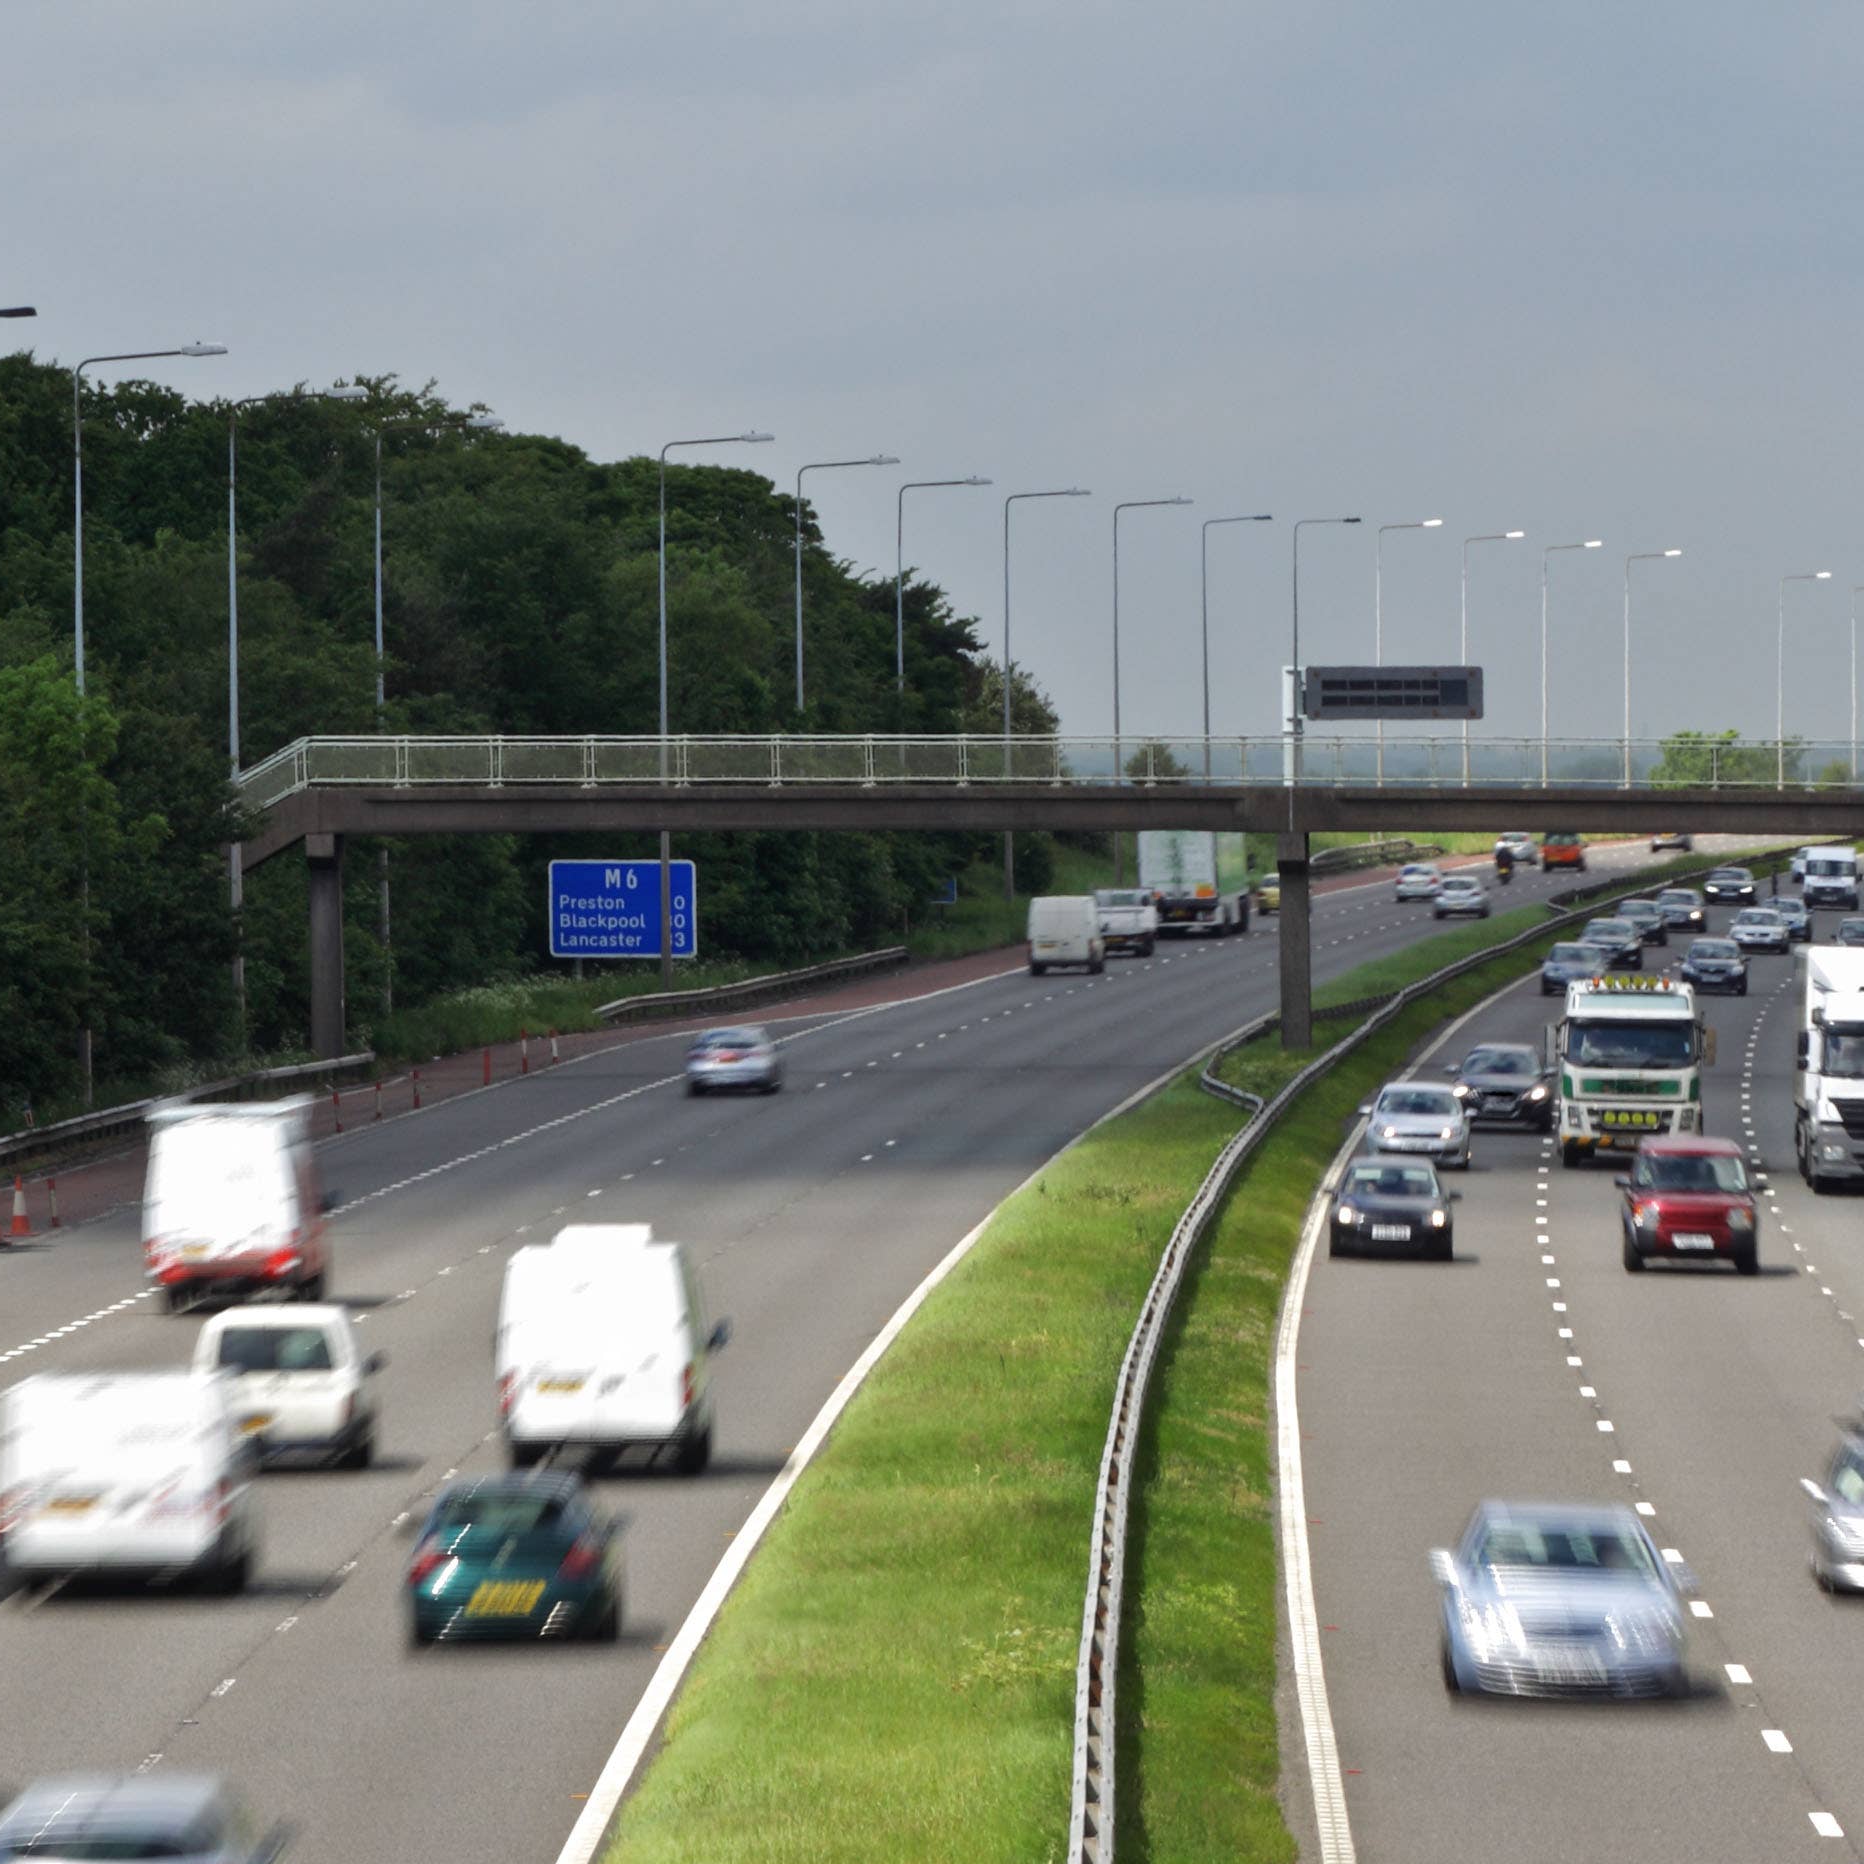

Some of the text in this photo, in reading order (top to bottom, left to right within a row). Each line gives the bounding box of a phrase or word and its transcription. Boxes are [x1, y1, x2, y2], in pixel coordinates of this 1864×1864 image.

[559, 894, 625, 910] Preston
[559, 913, 646, 931] Blackpool
[559, 932, 642, 947] Lancaster
